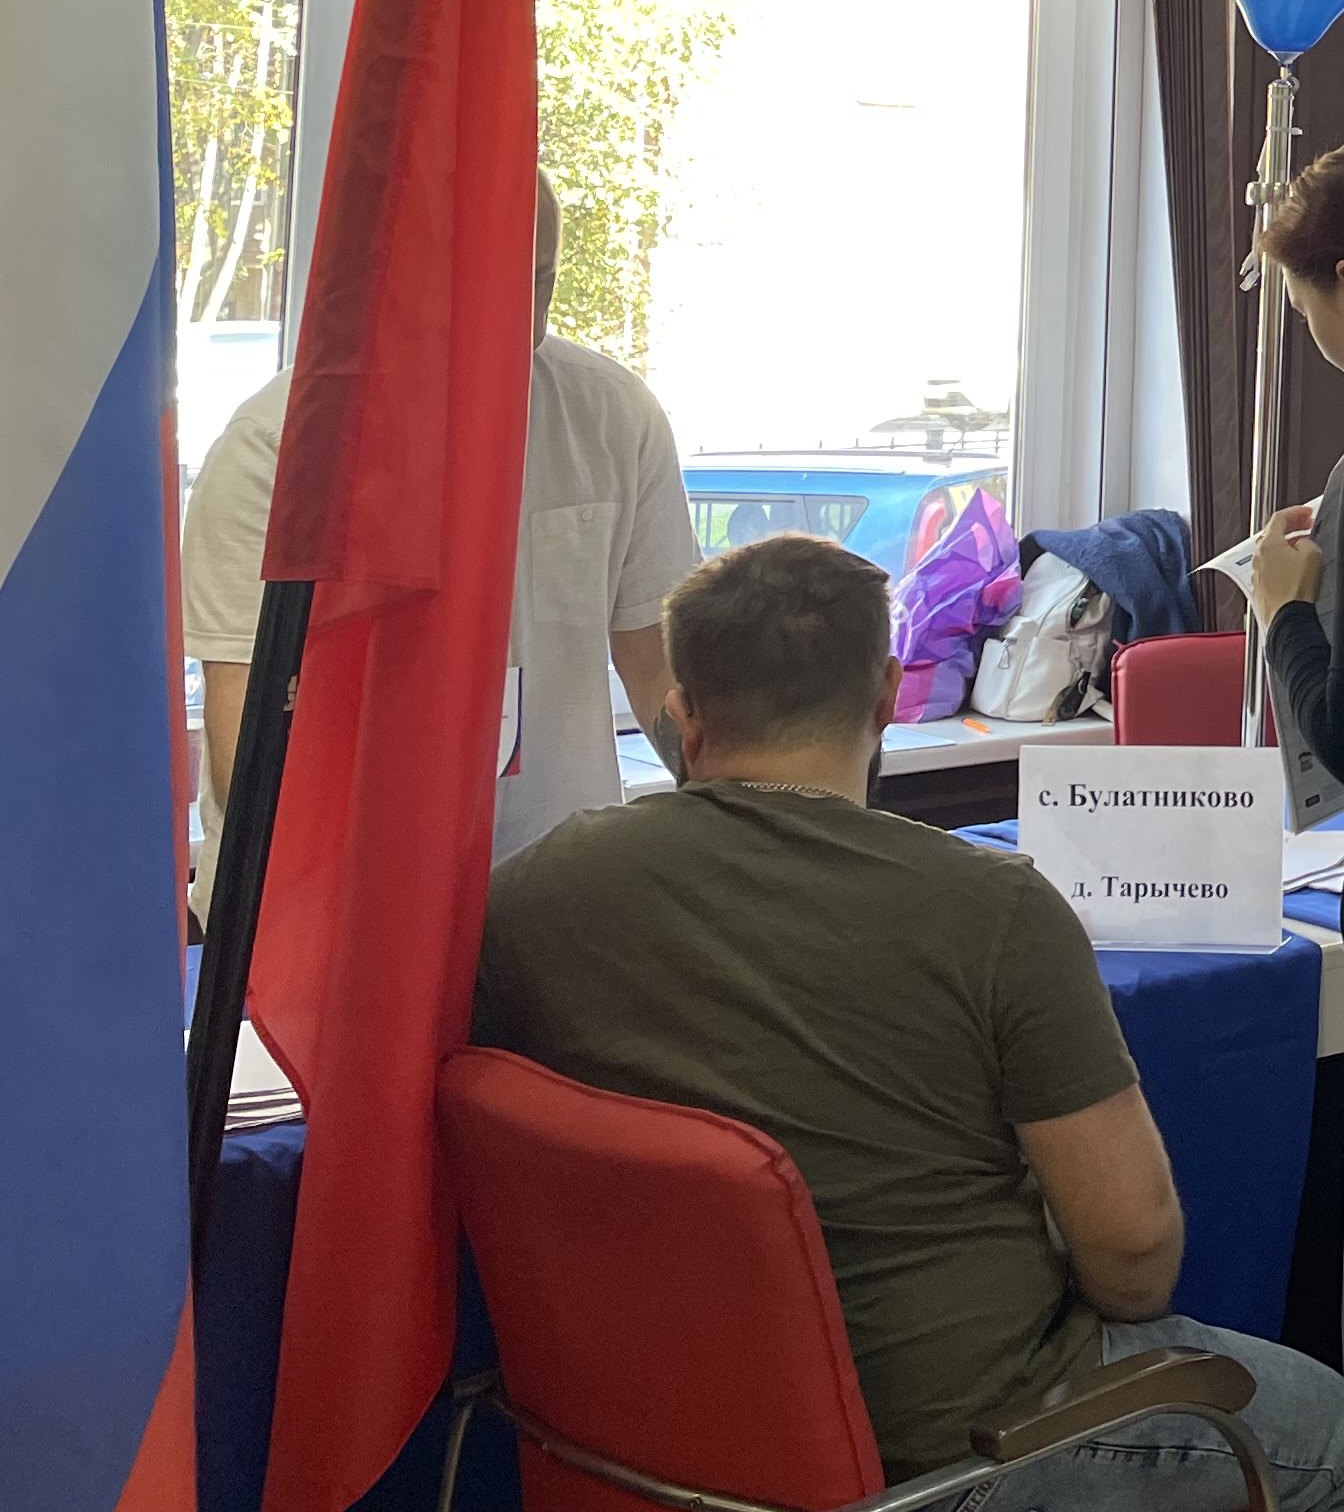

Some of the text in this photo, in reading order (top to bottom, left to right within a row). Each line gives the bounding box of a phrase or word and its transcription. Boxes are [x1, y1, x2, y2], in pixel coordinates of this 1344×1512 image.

[1038, 784, 1254, 813] с. Булатниково
[1070, 876, 1229, 903] д. Тарычево
